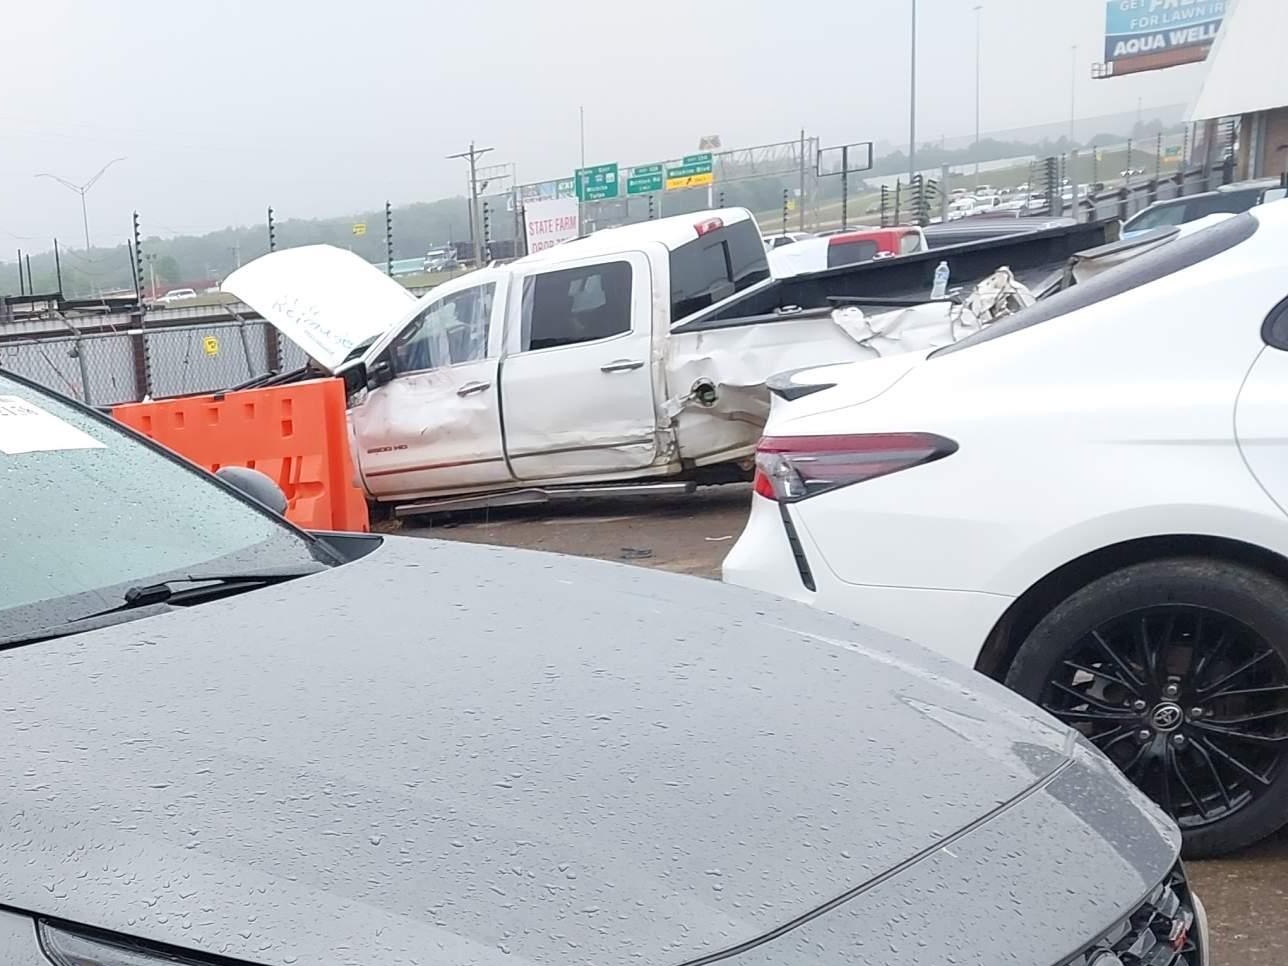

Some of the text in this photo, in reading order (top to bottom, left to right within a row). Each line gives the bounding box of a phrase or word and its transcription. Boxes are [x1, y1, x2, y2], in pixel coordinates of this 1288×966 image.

[1130, 15, 1159, 30] FOR
[1162, 7, 1205, 23] LAWN
[1113, 33, 1166, 56] AQUA
[528, 215, 577, 236] STATE FARM
